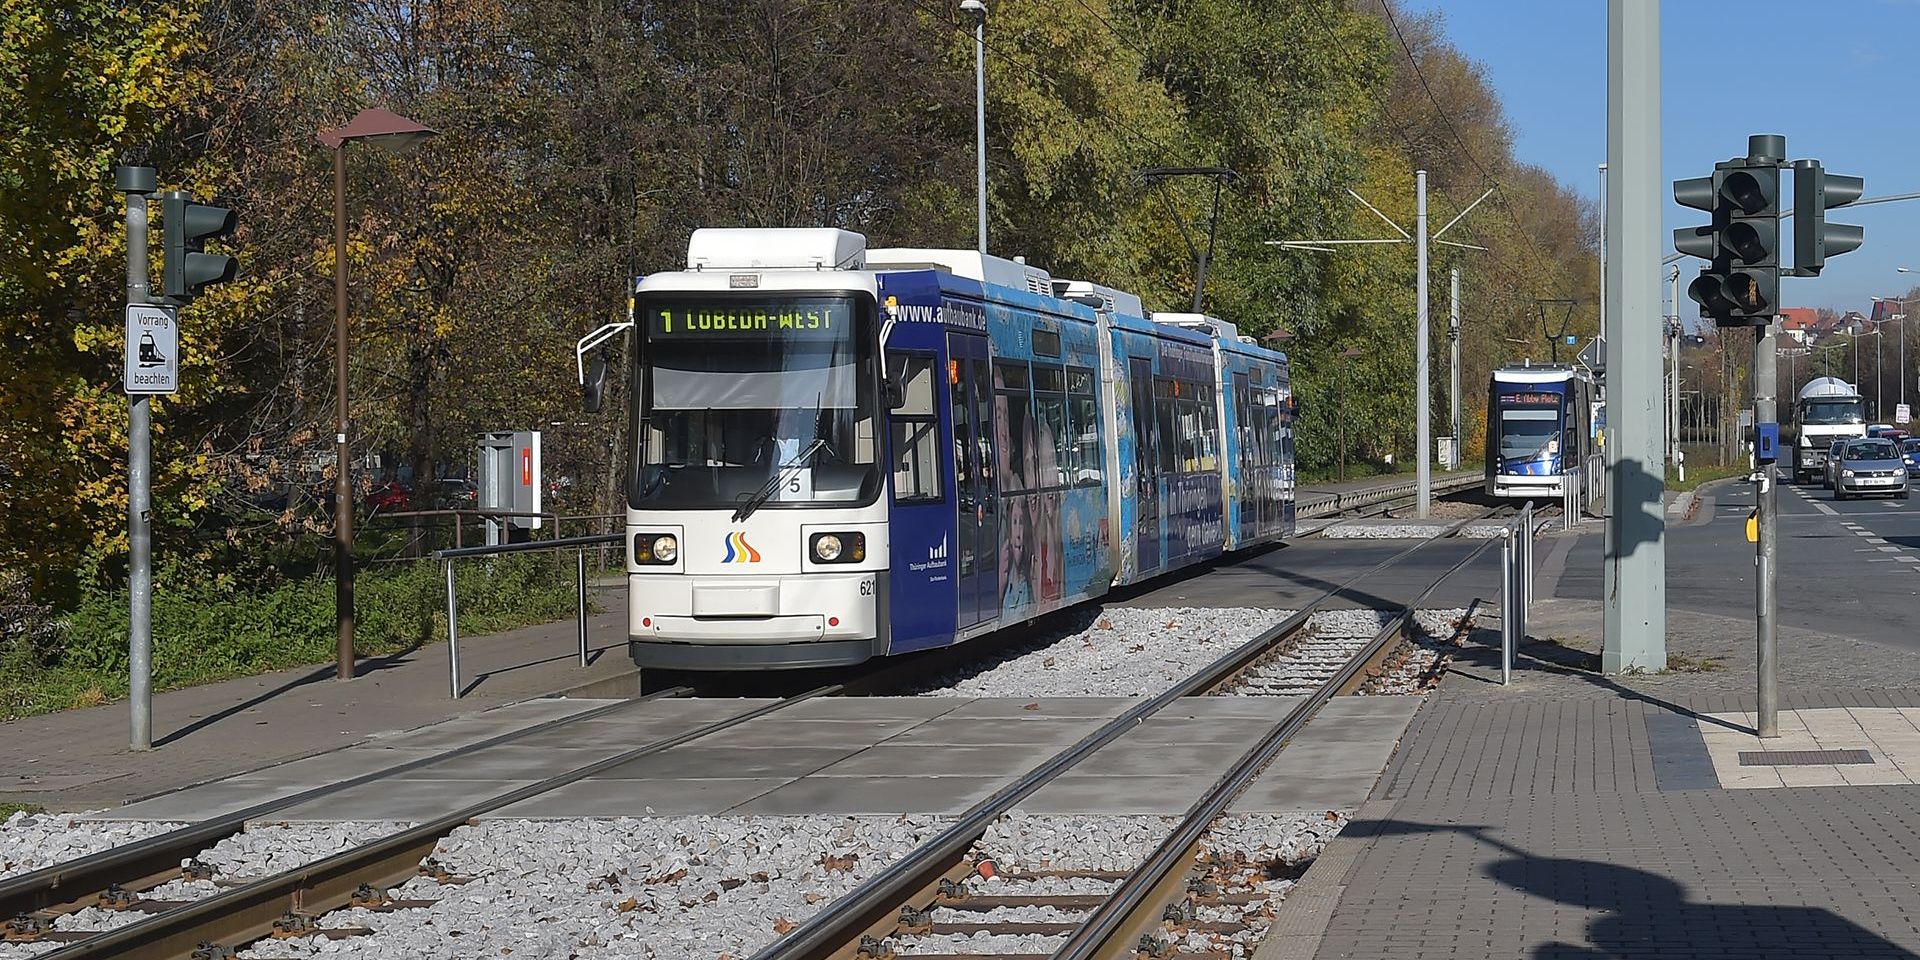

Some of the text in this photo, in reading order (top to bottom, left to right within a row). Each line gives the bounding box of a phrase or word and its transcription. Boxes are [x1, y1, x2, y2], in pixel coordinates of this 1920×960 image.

[137, 313, 169, 329] Vorrang
[661, 309, 832, 333] 1 LOBEDA-WEST
[897, 302, 985, 330] www.aufbaubank.de
[135, 372, 169, 385] beachten
[790, 478, 801, 493] 5
[860, 580, 876, 596] 621
